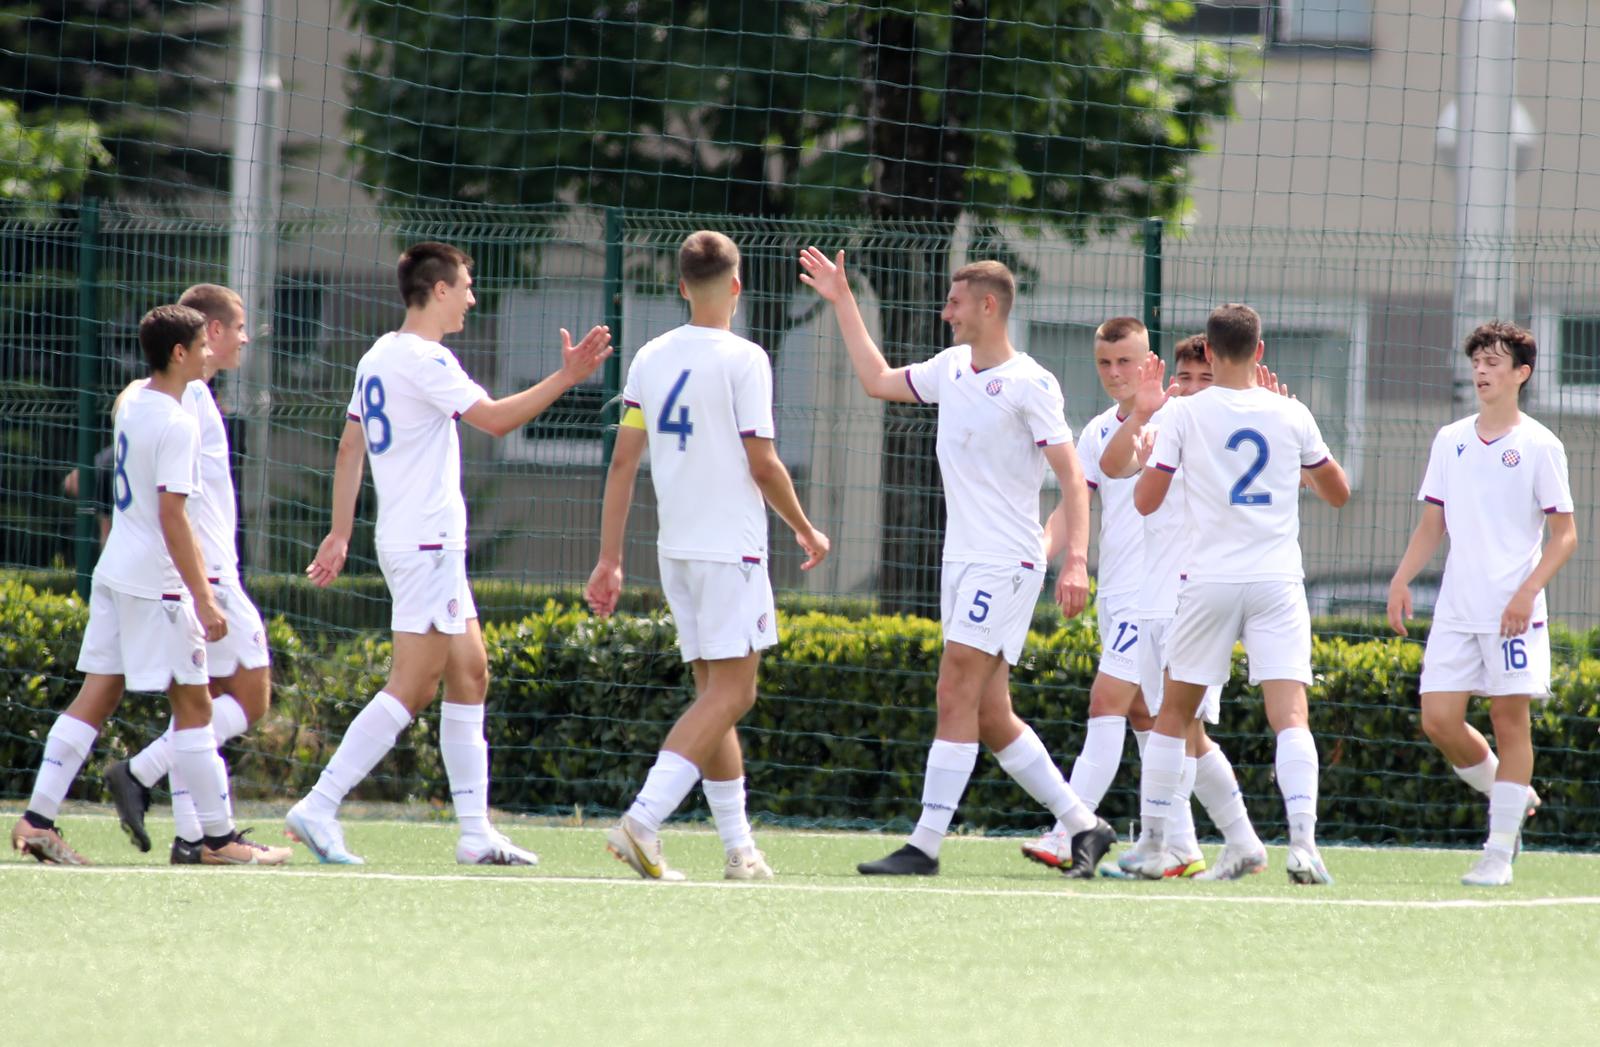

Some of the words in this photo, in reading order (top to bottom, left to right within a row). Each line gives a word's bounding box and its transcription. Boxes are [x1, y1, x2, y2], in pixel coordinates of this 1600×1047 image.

[657, 369, 693, 452] 4
[114, 430, 132, 512] 8
[1225, 427, 1272, 506] 2
[969, 589, 992, 623] 5
[1112, 621, 1138, 653] 17
[1502, 638, 1528, 671] 16
